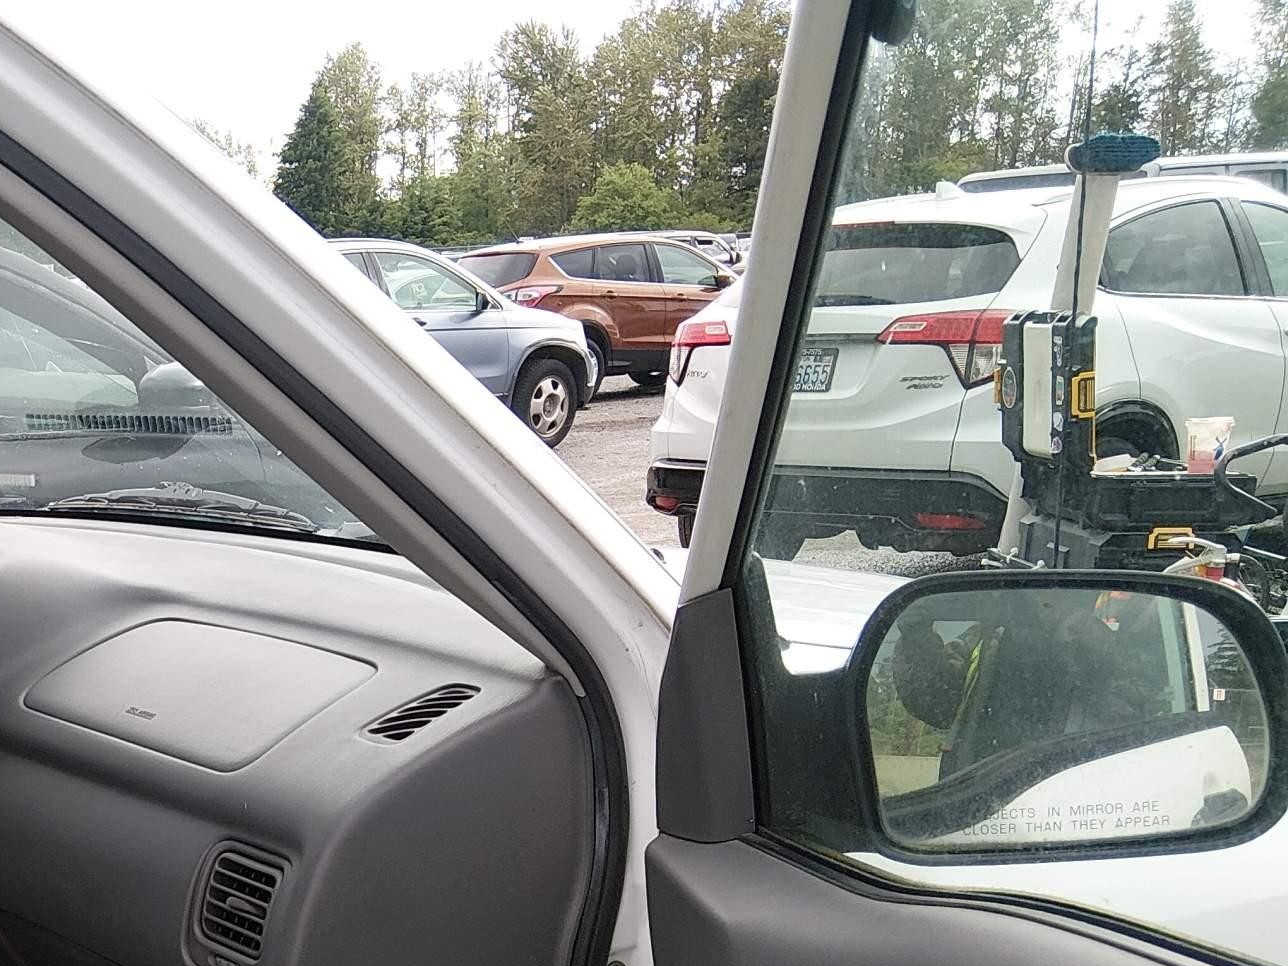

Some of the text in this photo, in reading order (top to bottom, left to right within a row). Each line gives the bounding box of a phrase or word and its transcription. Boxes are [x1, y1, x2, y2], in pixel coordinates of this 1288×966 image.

[987, 800, 1161, 821] JECTS IN MIRROR ARE
[962, 815, 1170, 836] CLOSER THAN THEY APPEAR
